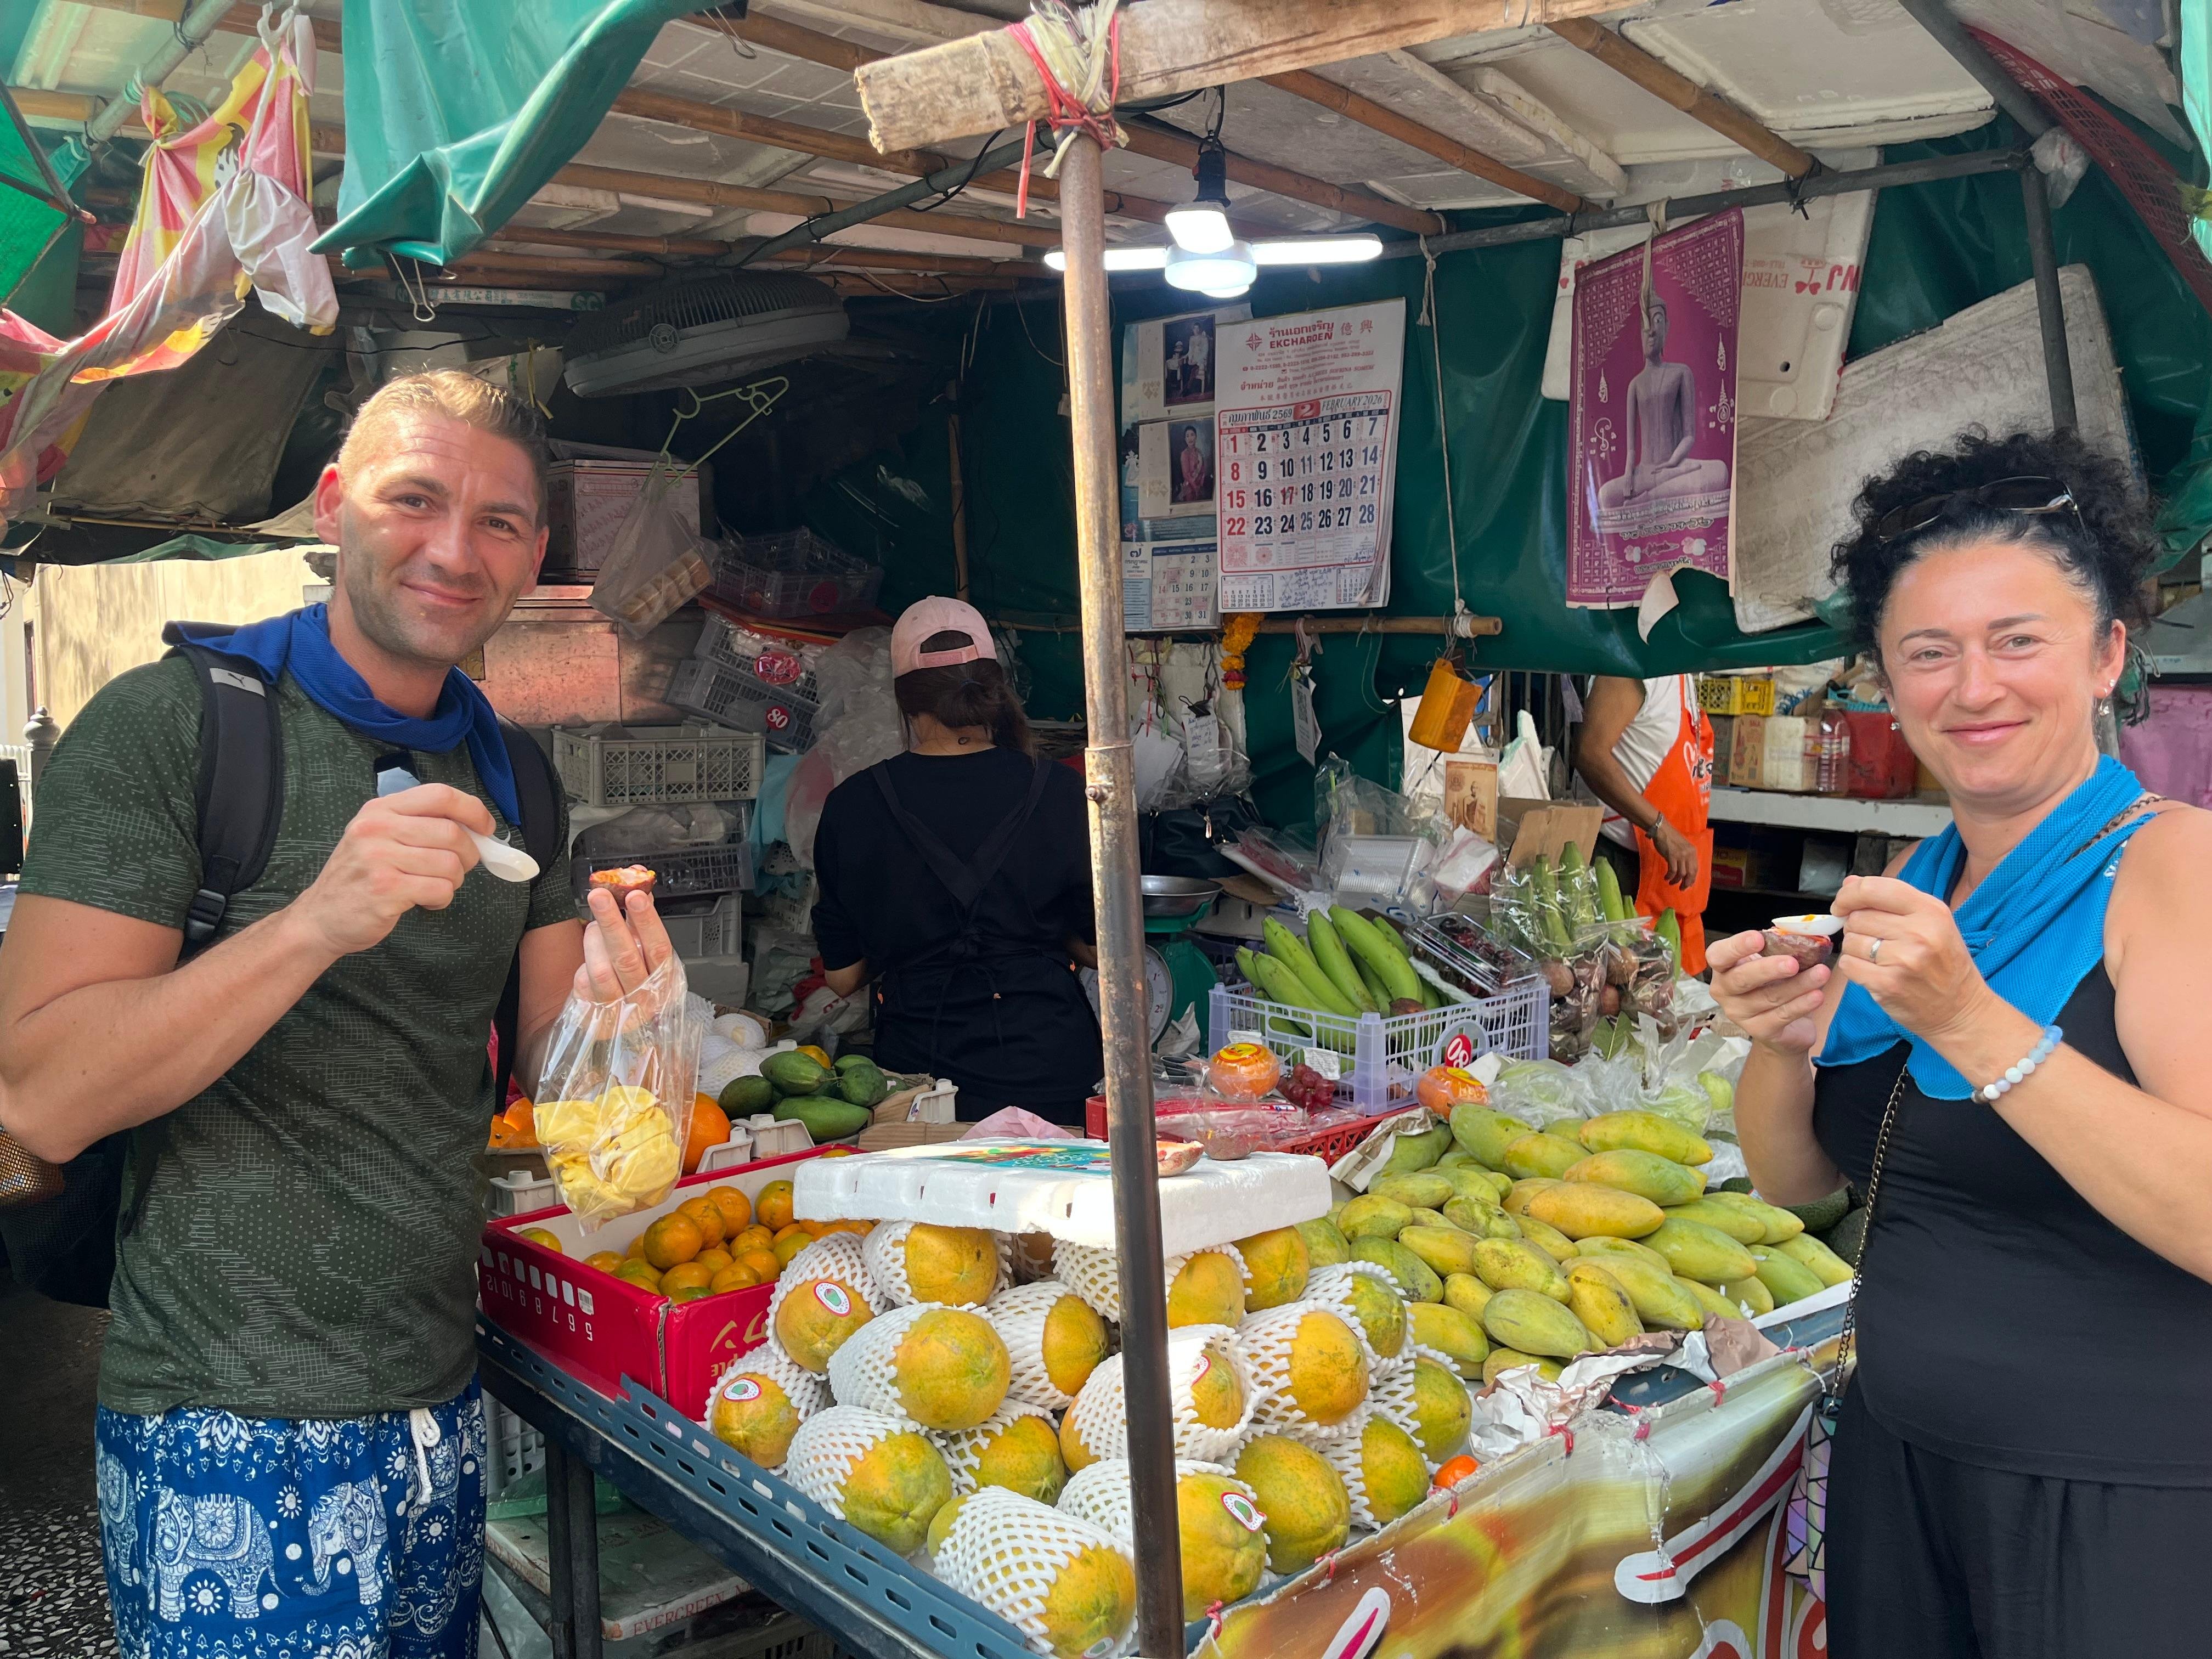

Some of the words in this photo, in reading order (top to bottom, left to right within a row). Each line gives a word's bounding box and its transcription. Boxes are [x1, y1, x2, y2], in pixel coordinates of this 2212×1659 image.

[1301, 403, 1313, 417] 2
[1322, 396, 1363, 411] FEBRUARY
[1363, 394, 1383, 405] 2026
[1273, 408, 1292, 420] 2569
[1231, 435, 1237, 453] 1
[1257, 433, 1266, 452] 2
[1283, 431, 1289, 449] 3
[1303, 427, 1309, 445] 4
[1323, 424, 1330, 442] 5
[1344, 420, 1351, 439] 6
[1369, 417, 1378, 436] 7
[1231, 462, 1239, 481] 8
[1258, 461, 1267, 479] 9
[1280, 458, 1294, 477] 10
[1301, 455, 1312, 474] 11
[1321, 452, 1333, 471] 12
[1340, 448, 1353, 467] 13
[1363, 445, 1378, 465] 14
[1227, 490, 1245, 508] 15
[1255, 489, 1272, 507] 16
[1281, 487, 1294, 505] 17
[1302, 483, 1313, 503] 18
[1320, 480, 1332, 500] 19
[1339, 477, 1352, 497] 20
[1360, 475, 1375, 495] 21
[1228, 517, 1245, 535] 22
[1255, 516, 1272, 535] 23
[1281, 514, 1294, 533] 24
[1301, 511, 1312, 530] 25
[1319, 509, 1331, 528] 26
[1338, 506, 1351, 526] 27
[1359, 504, 1374, 524] 28
[768, 709, 788, 728] 80
[486, 1274, 498, 1293] 12
[502, 1281, 513, 1301] 10
[535, 1297, 541, 1314] 8
[552, 1306, 558, 1323] 7
[568, 1313, 575, 1332] 6
[585, 1322, 592, 1341] 5
